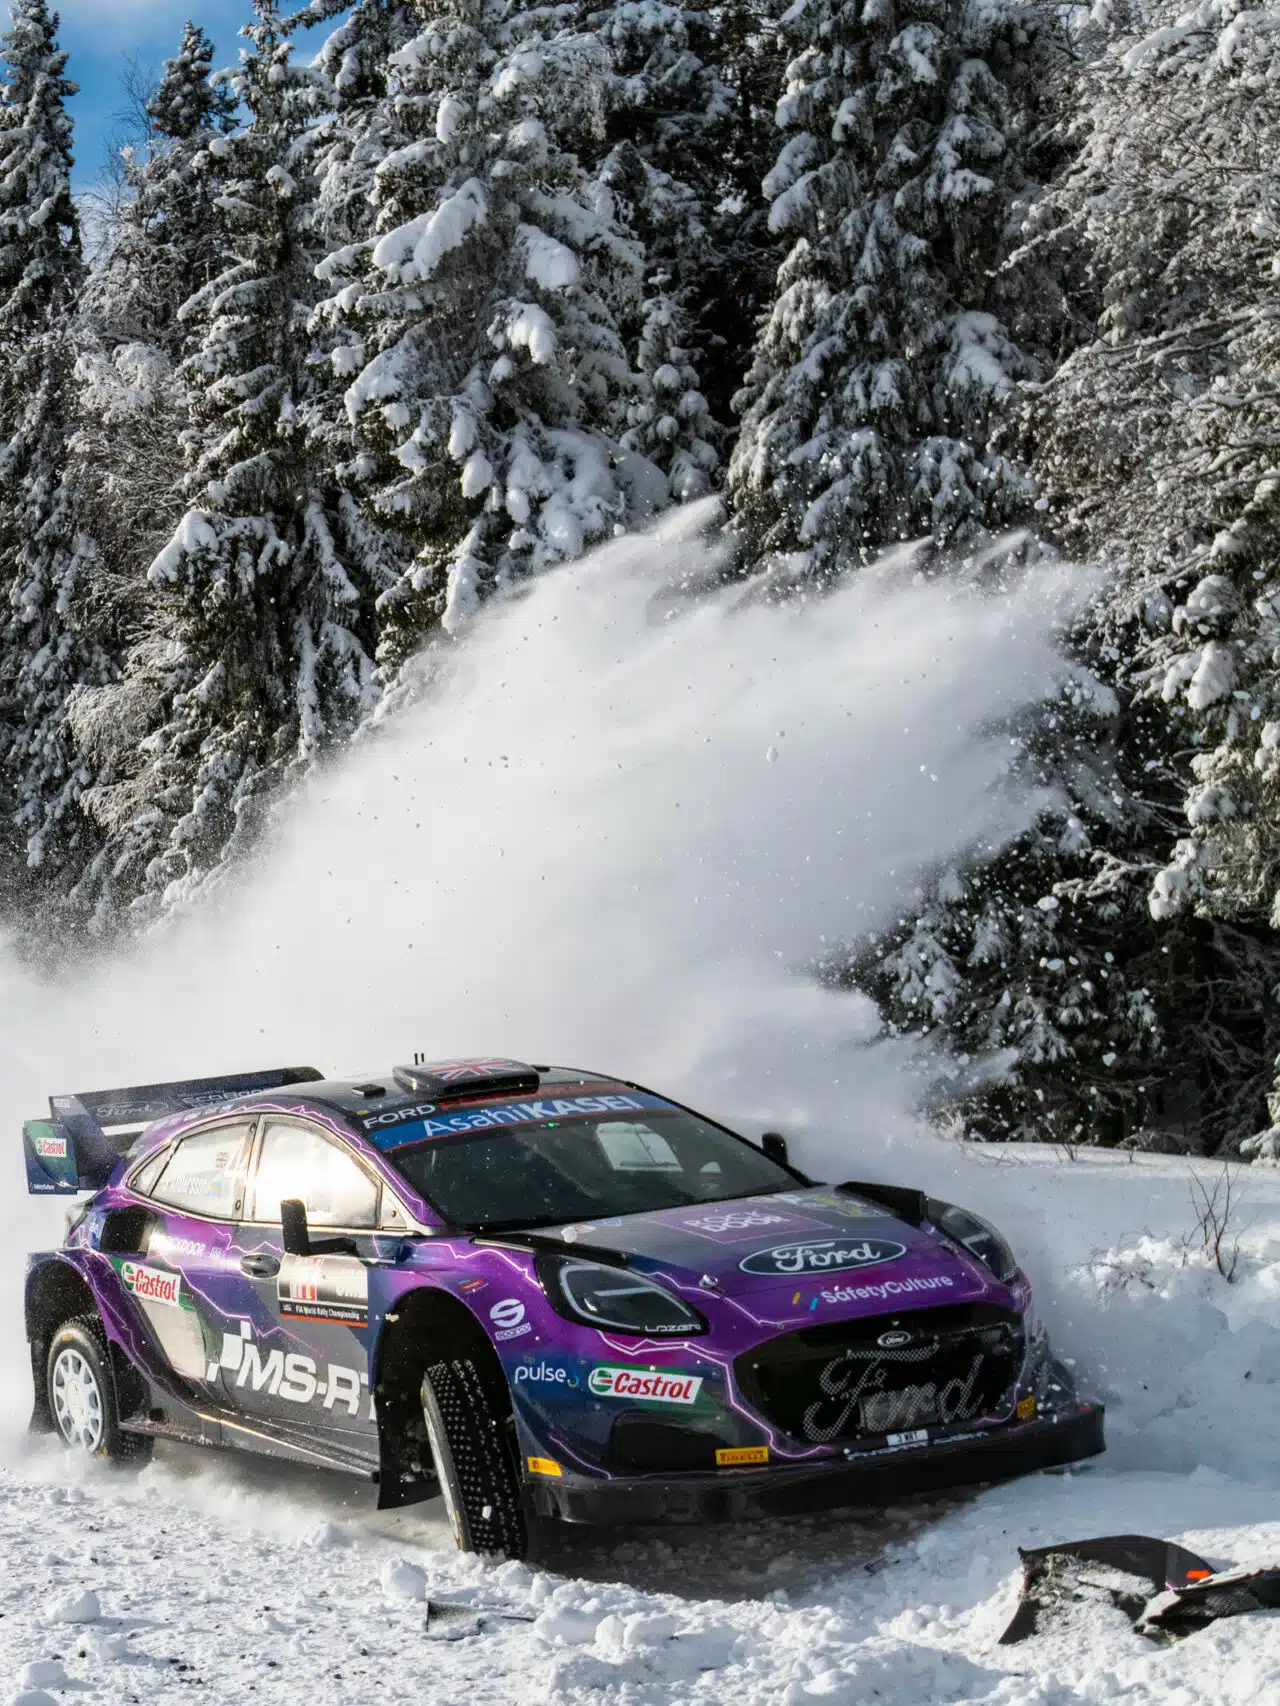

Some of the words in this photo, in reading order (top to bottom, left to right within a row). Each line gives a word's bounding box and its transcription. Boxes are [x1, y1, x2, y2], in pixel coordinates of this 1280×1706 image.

[363, 1104, 437, 1129] FORD
[423, 1095, 645, 1138] AsahiKASEI
[771, 1242, 881, 1272] Ford
[135, 1268, 178, 1302] Castrol
[820, 1273, 954, 1304] SafetyCulture
[317, 1307, 328, 1318] Rally
[329, 1308, 361, 1320] Championship
[514, 1361, 567, 1384] pulse
[614, 1371, 693, 1400] Castrol
[801, 1340, 986, 1442] Ford
